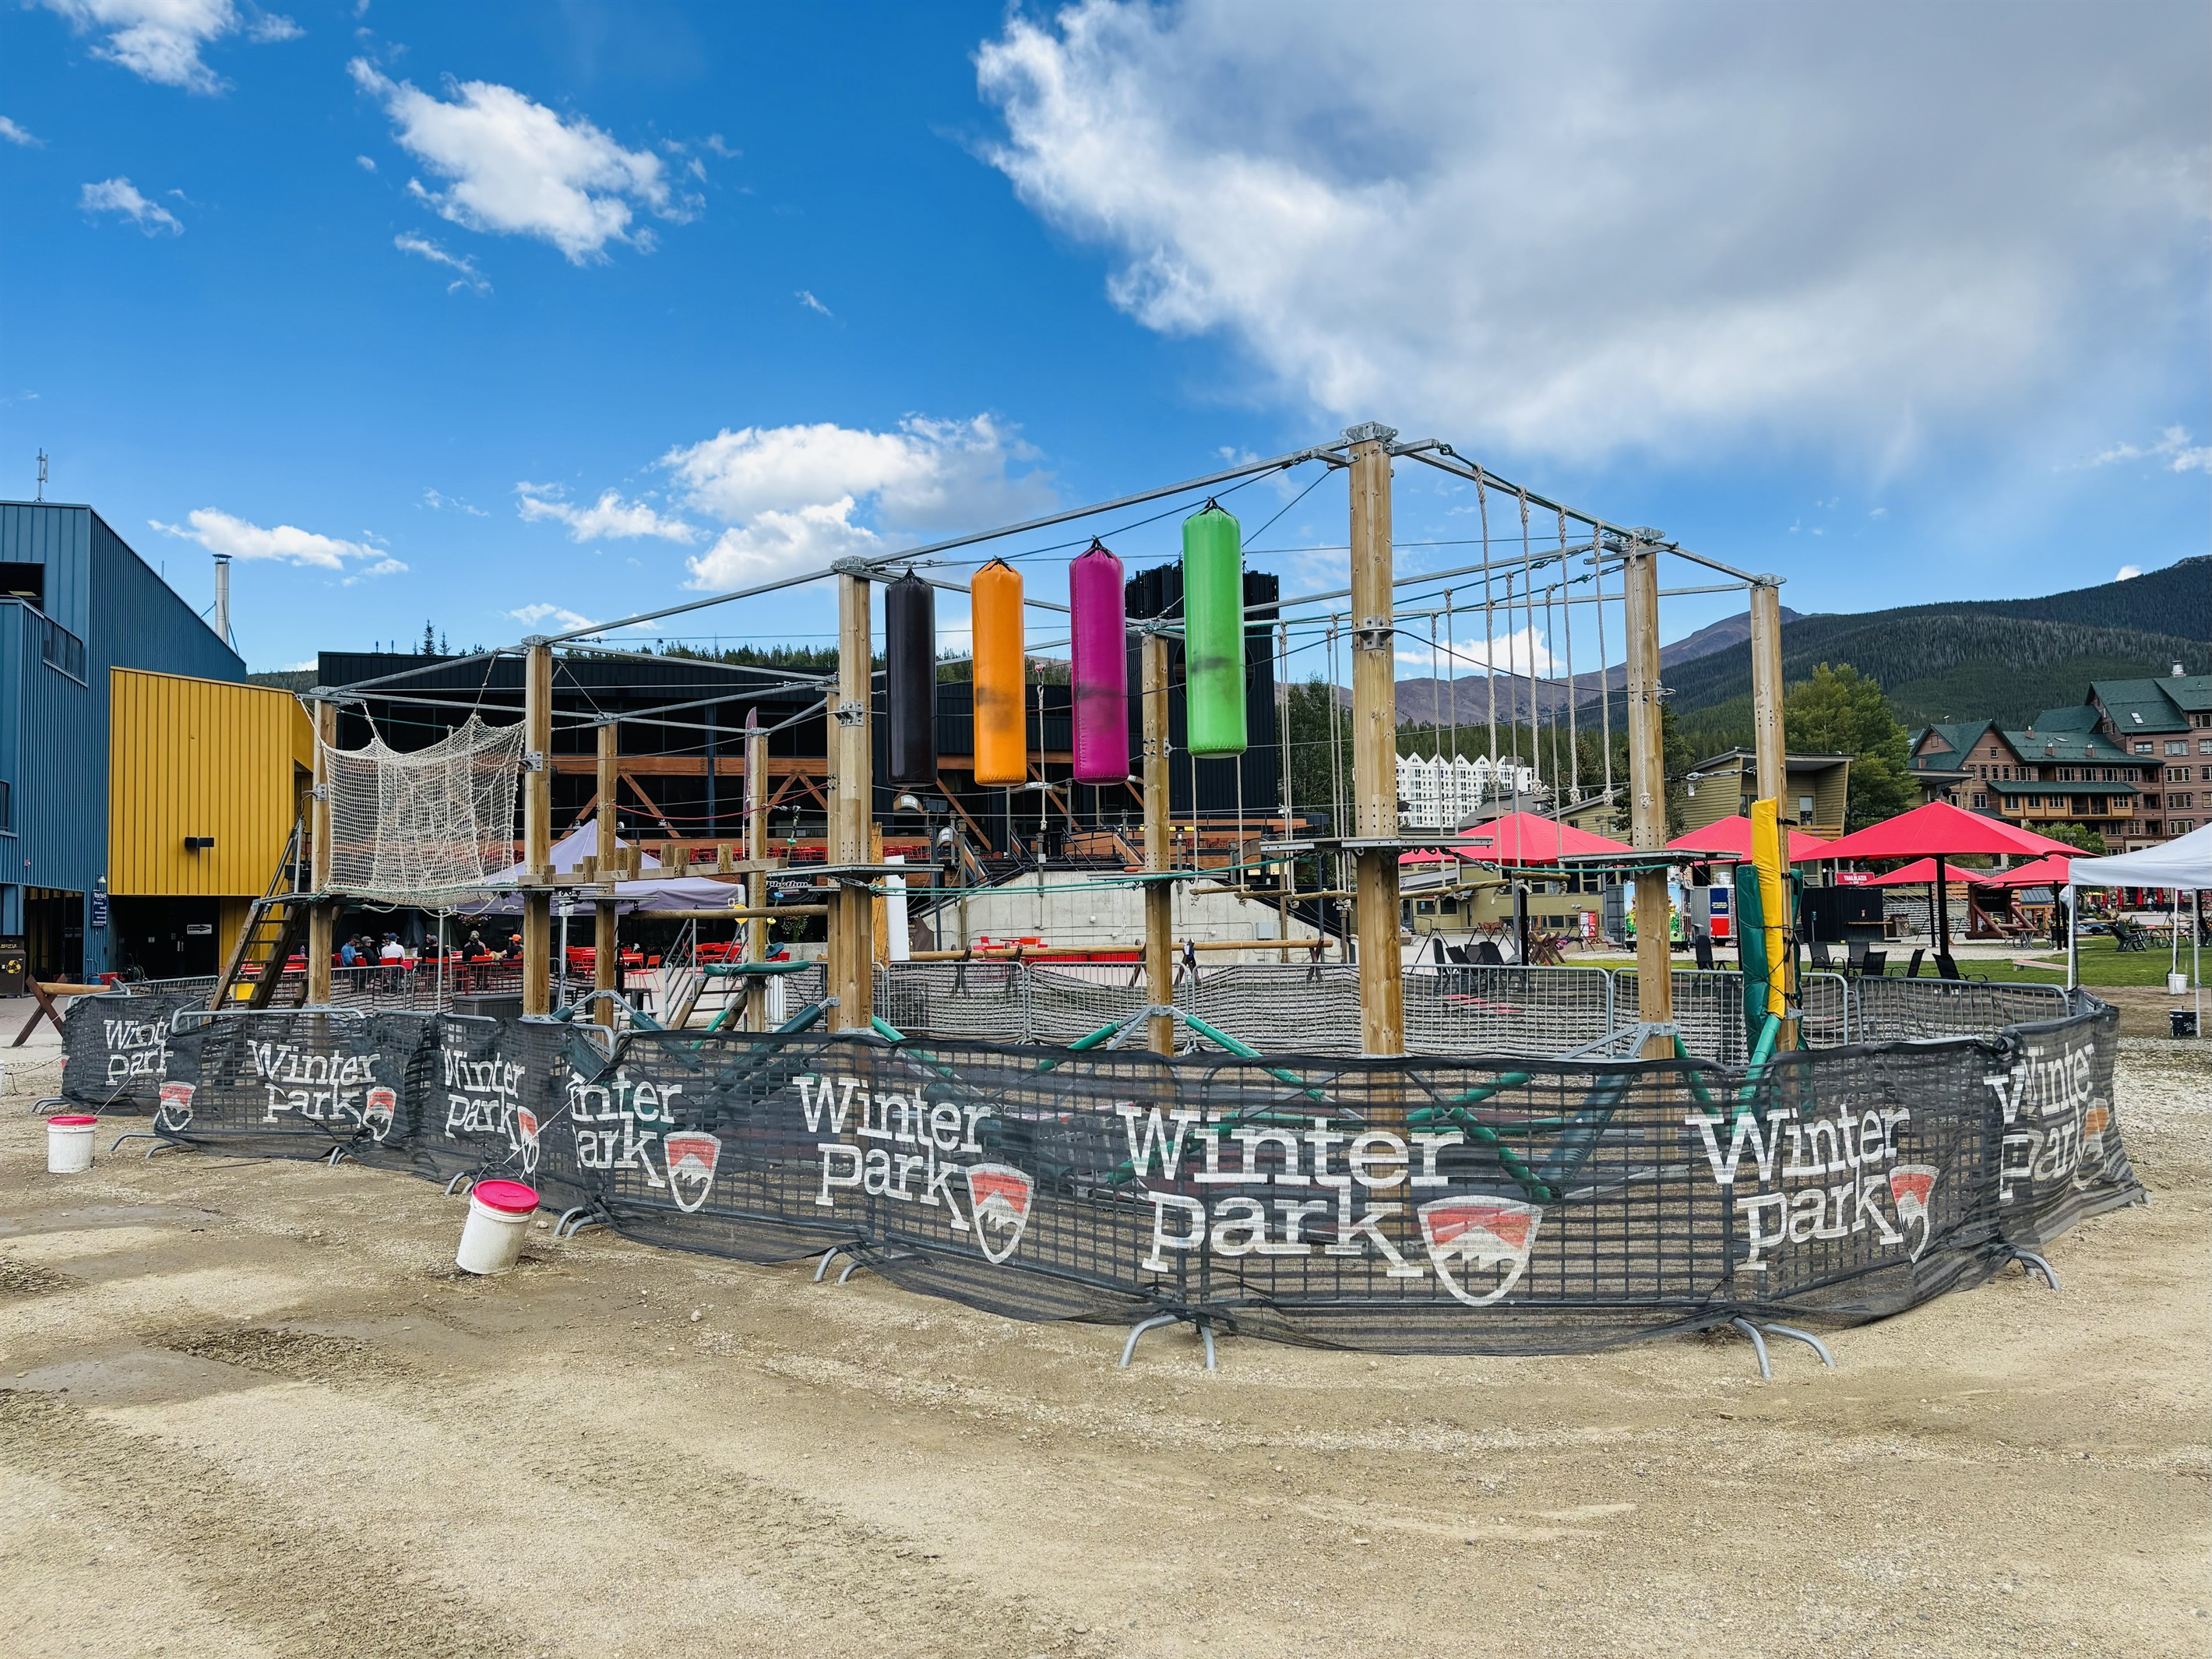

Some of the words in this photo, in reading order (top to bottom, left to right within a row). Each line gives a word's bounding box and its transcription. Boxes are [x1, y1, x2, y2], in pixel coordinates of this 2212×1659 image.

[247, 1040, 380, 1084] Winter
[441, 1044, 525, 1099] Winter
[792, 1076, 993, 1153] Winter
[1116, 1105, 1464, 1188] Winter
[1685, 1104, 1910, 1184] Winter
[572, 1122, 665, 1189] ark
